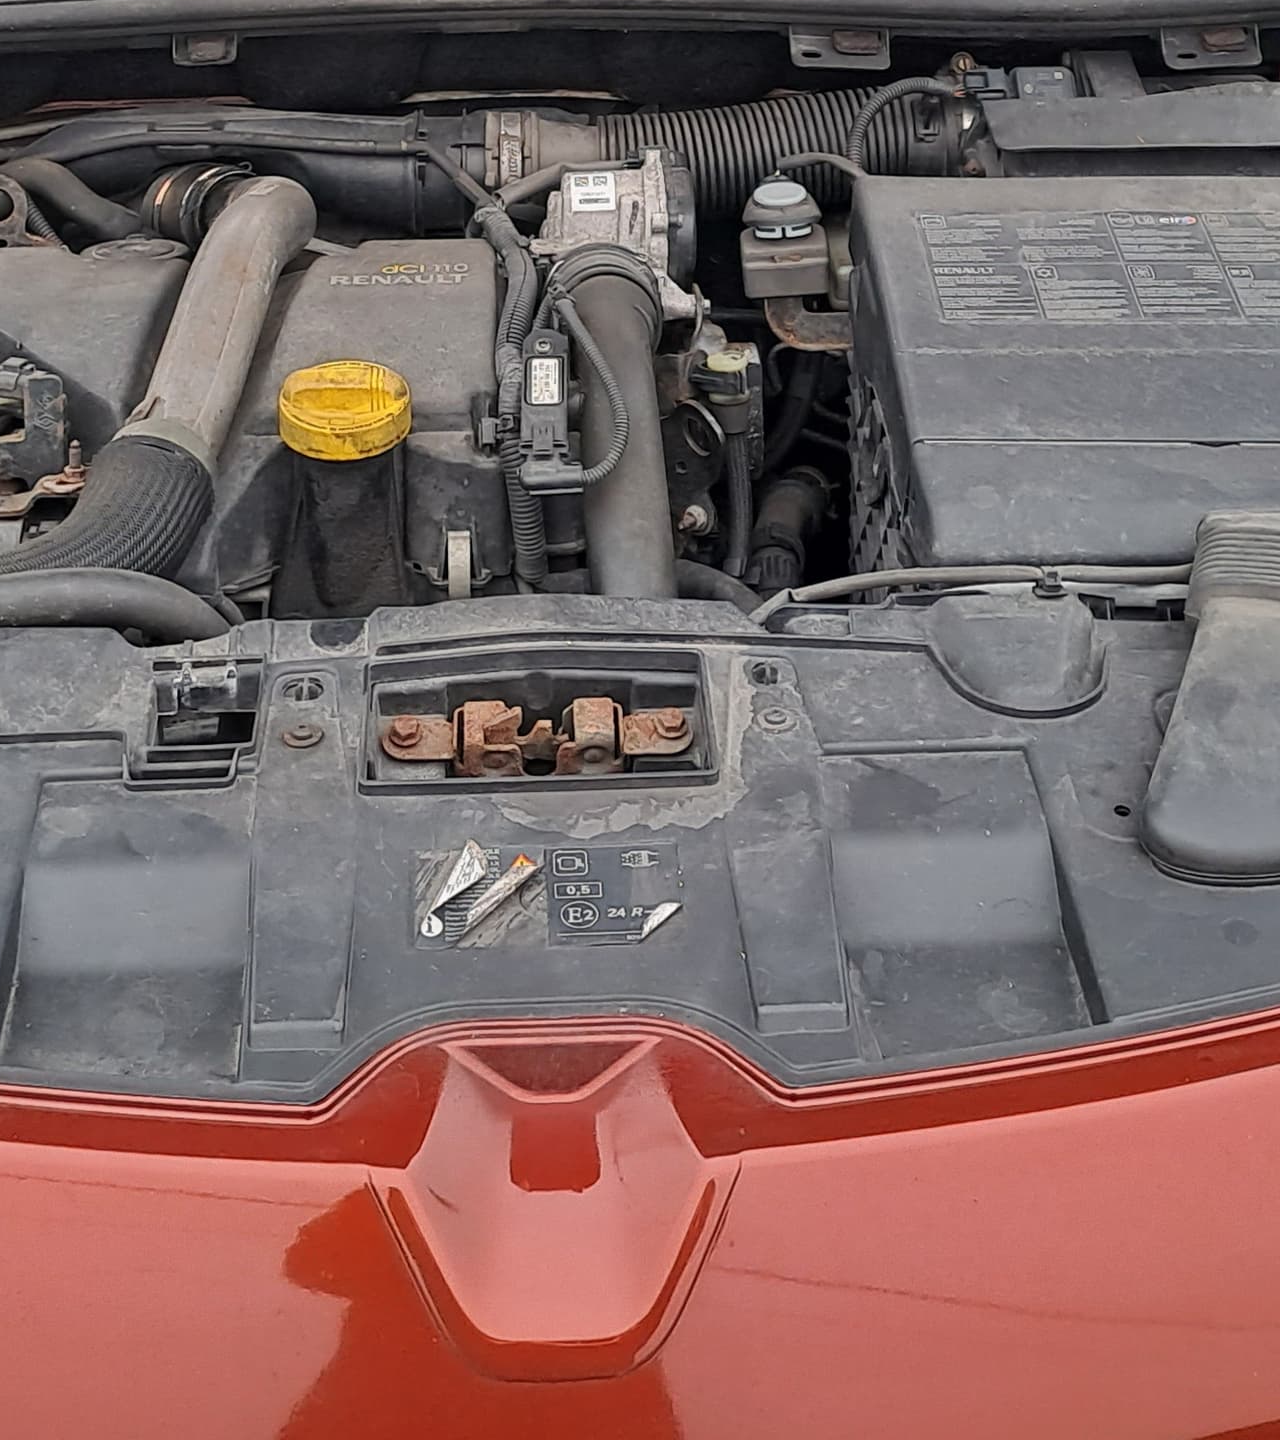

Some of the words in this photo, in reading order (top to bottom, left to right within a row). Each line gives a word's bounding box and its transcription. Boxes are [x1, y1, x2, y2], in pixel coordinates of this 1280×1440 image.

[932, 266, 996, 276] RENAULT
[329, 274, 469, 285] RENAULT
[565, 885, 591, 897] 0,5
[566, 907, 595, 924] E2
